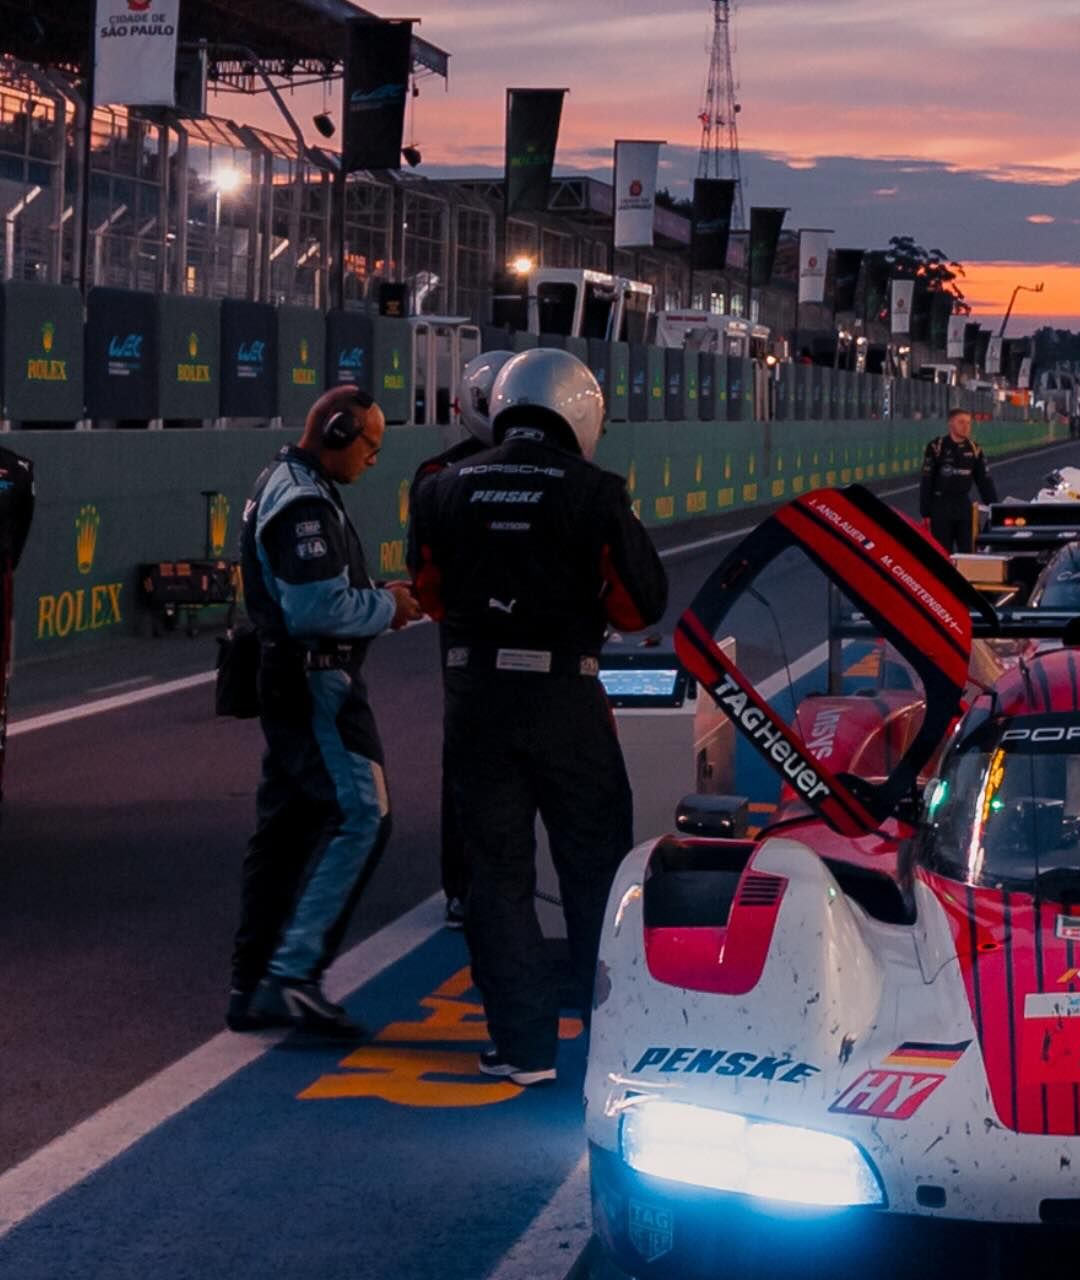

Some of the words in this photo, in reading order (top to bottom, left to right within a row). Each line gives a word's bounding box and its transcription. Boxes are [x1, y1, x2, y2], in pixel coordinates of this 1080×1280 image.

[108, 14, 148, 24] CIDADE
[151, 14, 166, 23] DE
[130, 25, 174, 36] PAULO
[27, 359, 67, 380] ROLEX
[459, 464, 565, 477] PORSCHE
[470, 491, 543, 503] PENSKE
[815, 502, 866, 543] ANDLAUER
[297, 539, 325, 558] FIA
[891, 565, 953, 624] CHRISTENSEN
[37, 583, 124, 639] ROLEX
[631, 1047, 821, 1084] PENSKE
[838, 1072, 930, 1114] HY
